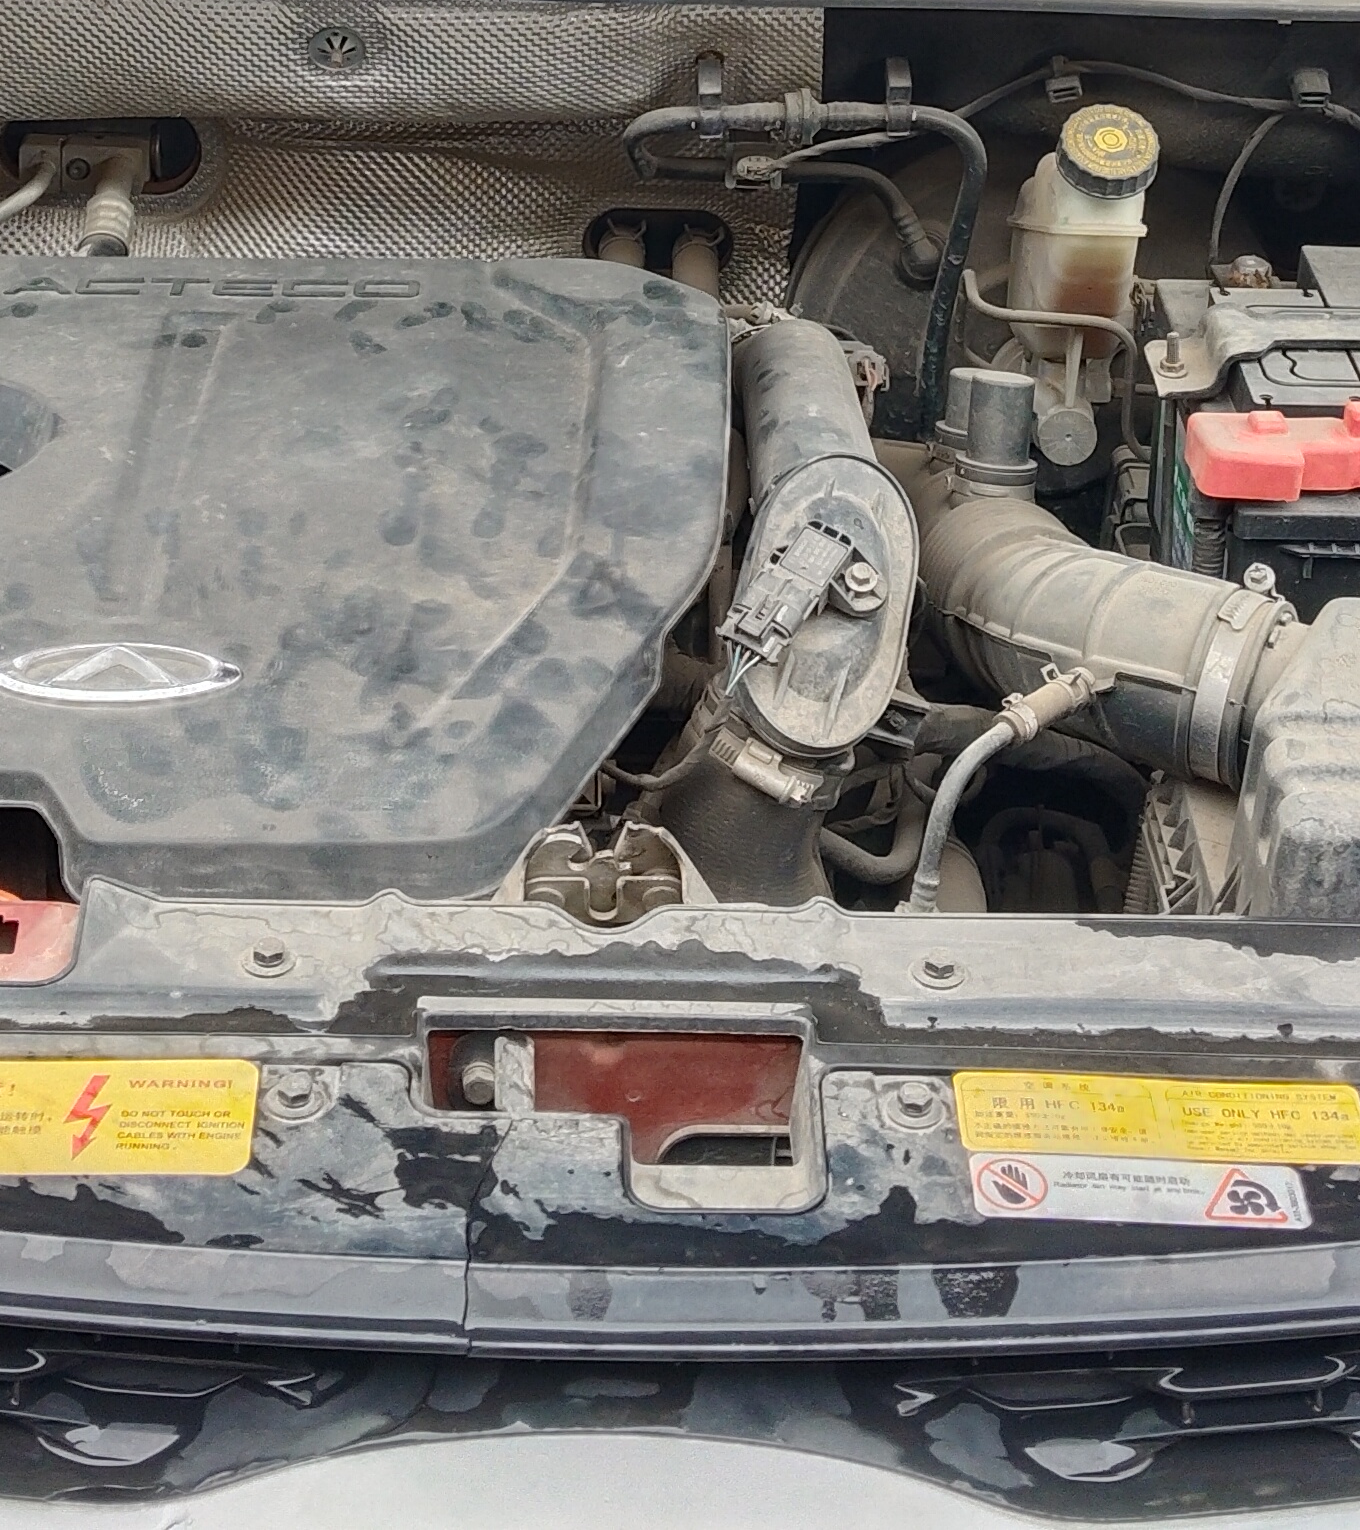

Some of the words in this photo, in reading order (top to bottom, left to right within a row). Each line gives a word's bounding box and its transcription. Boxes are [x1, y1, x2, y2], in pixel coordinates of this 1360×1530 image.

[2, 276, 422, 298] ACTECO
[128, 1079, 233, 1089] WARNING!
[992, 1096, 1035, 1109] 限用
[121, 1110, 138, 1118] DO
[142, 1110, 166, 1118] NOT
[170, 1110, 211, 1118] TOUCH
[214, 1110, 231, 1118] OR
[1182, 1107, 1212, 1117] USE
[1221, 1108, 1261, 1119] ONLY
[1269, 1110, 1301, 1120] HFC
[1311, 1111, 1351, 1122] 134a
[119, 1120, 191, 1129] DISCONNECT
[196, 1121, 245, 1129] IGNITION
[117, 1131, 163, 1139] CABLES
[198, 1132, 241, 1140] ENGINE
